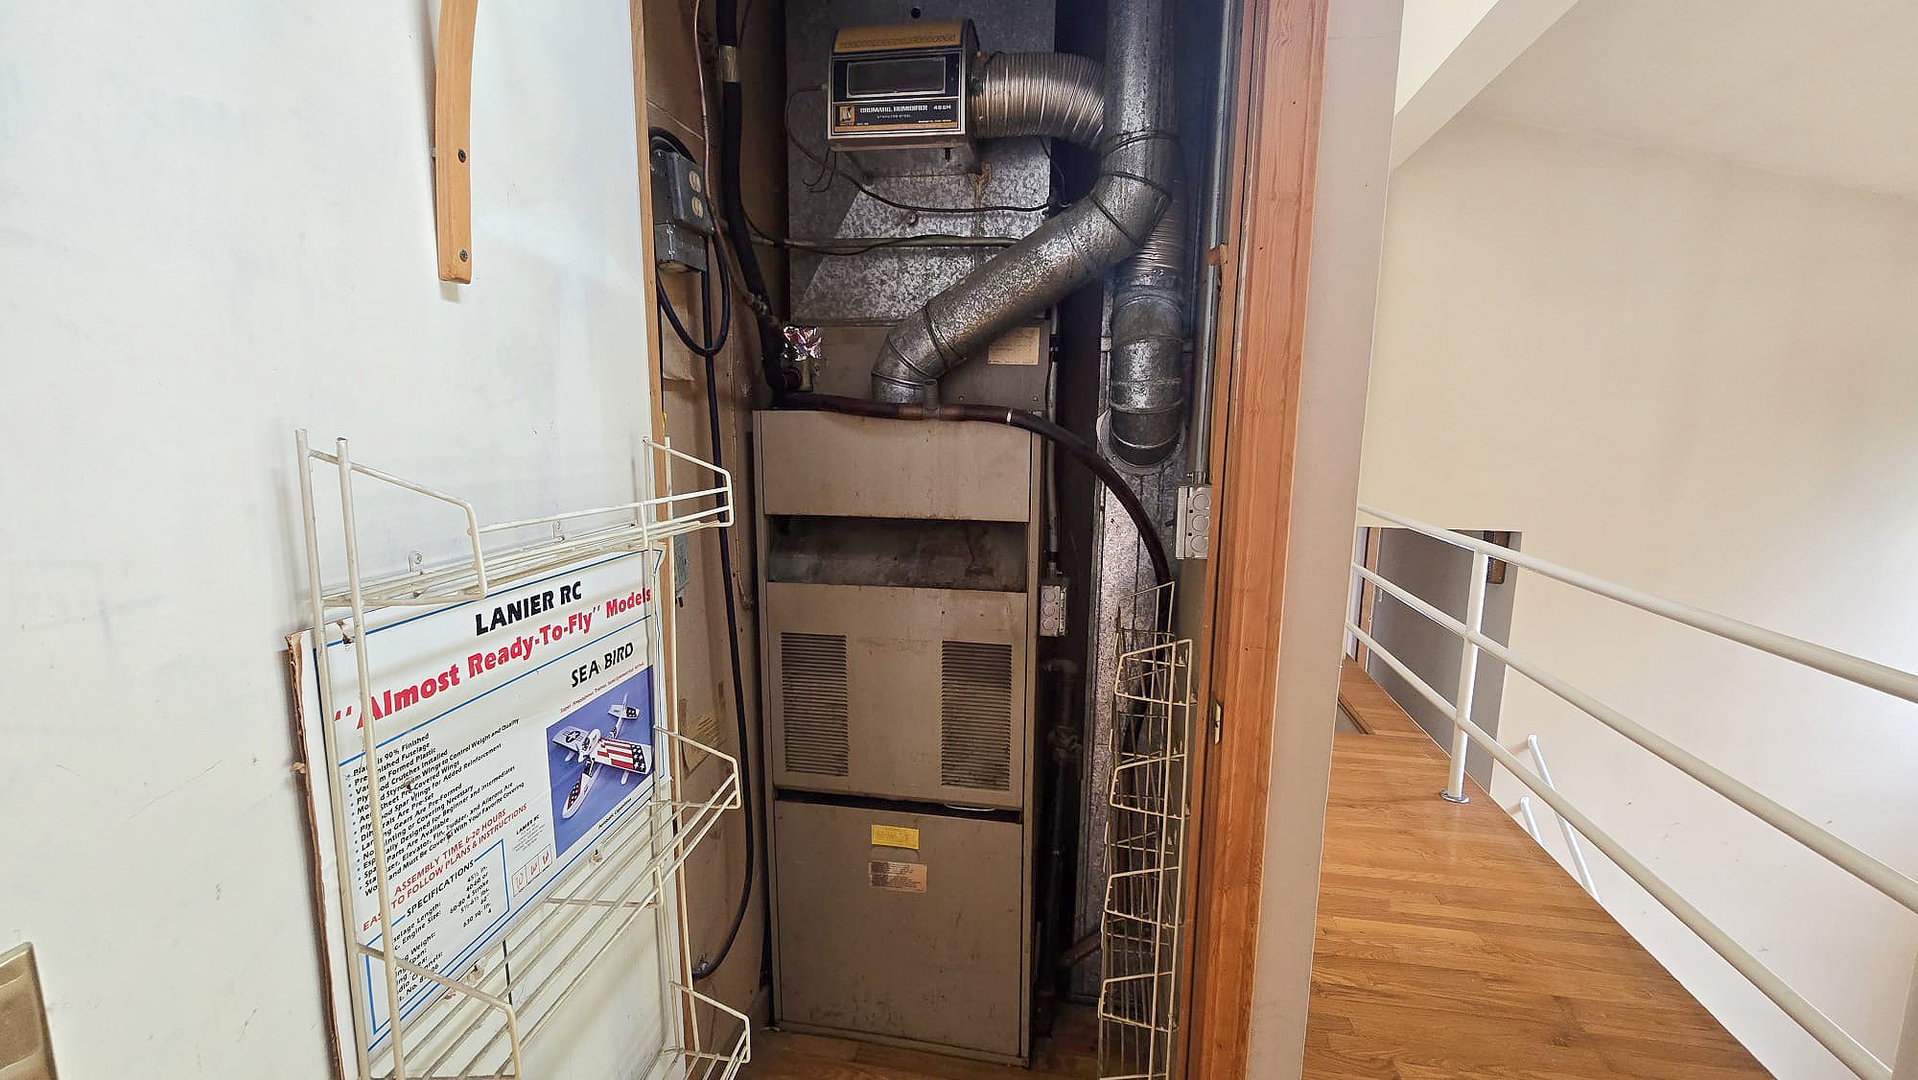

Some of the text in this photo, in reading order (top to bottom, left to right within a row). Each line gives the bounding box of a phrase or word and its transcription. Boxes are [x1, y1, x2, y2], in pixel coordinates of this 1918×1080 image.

[475, 581, 582, 636] LANIER RC
[606, 587, 651, 618] Models
[571, 642, 634, 688] SEA BIRD
[385, 748, 399, 760] 90%
[402, 733, 429, 751] Finished
[388, 759, 414, 777] Formed
[416, 748, 436, 762] Plastic
[391, 766, 420, 785] Crutches
[422, 749, 447, 768] Installed
[402, 743, 429, 761] Fuselage
[422, 763, 442, 776] Wings
[450, 745, 470, 760] Control
[471, 734, 490, 748] Weight
[491, 728, 501, 737] and
[502, 718, 519, 730] Quality
[441, 761, 459, 774] Wings
[395, 799, 409, 812] Spar
[411, 786, 430, 801] Wings
[432, 780, 441, 788] for
[443, 766, 462, 782] Added
[464, 743, 501, 769] Reinforcement
[363, 850, 374, 860] No
[417, 804, 445, 824] Covering
[447, 785, 473, 806] Necessary
[394, 815, 412, 830] Gears
[414, 807, 426, 817] Are
[428, 783, 461, 809] Pre-Formed
[397, 809, 409, 819] Are
[412, 793, 434, 810] Pre-Set
[401, 821, 430, 844] Designed
[432, 814, 441, 824] for
[443, 796, 468, 816] Beginner
[470, 788, 480, 798] and
[403, 839, 431, 861] Elevator,
[470, 804, 480, 815] and
[504, 783, 512, 791] Are
[387, 848, 404, 863] Parts
[406, 839, 418, 850] Are
[421, 818, 449, 840] Available
[388, 867, 401, 880] and
[403, 856, 418, 870] Must
[420, 850, 427, 858] Be
[454, 822, 467, 833] With
[468, 812, 481, 823] Your
[482, 797, 502, 814] Favorite
[503, 782, 524, 798] Covering
[395, 856, 439, 896] ASSEMBLY
[442, 840, 463, 859] TIME
[482, 809, 506, 831] HOURS
[391, 895, 405, 909] TO
[407, 865, 443, 898] FOLLOW
[446, 845, 470, 869] PLANS
[479, 803, 526, 844] INSTRUCTIONS
[407, 860, 473, 917] SPECIFICATIONS
[472, 880, 489, 896] Stroke
[403, 923, 425, 944] Engine
[427, 910, 441, 924] Size:
[417, 902, 441, 924] Length:
[411, 932, 435, 955] Weight:
